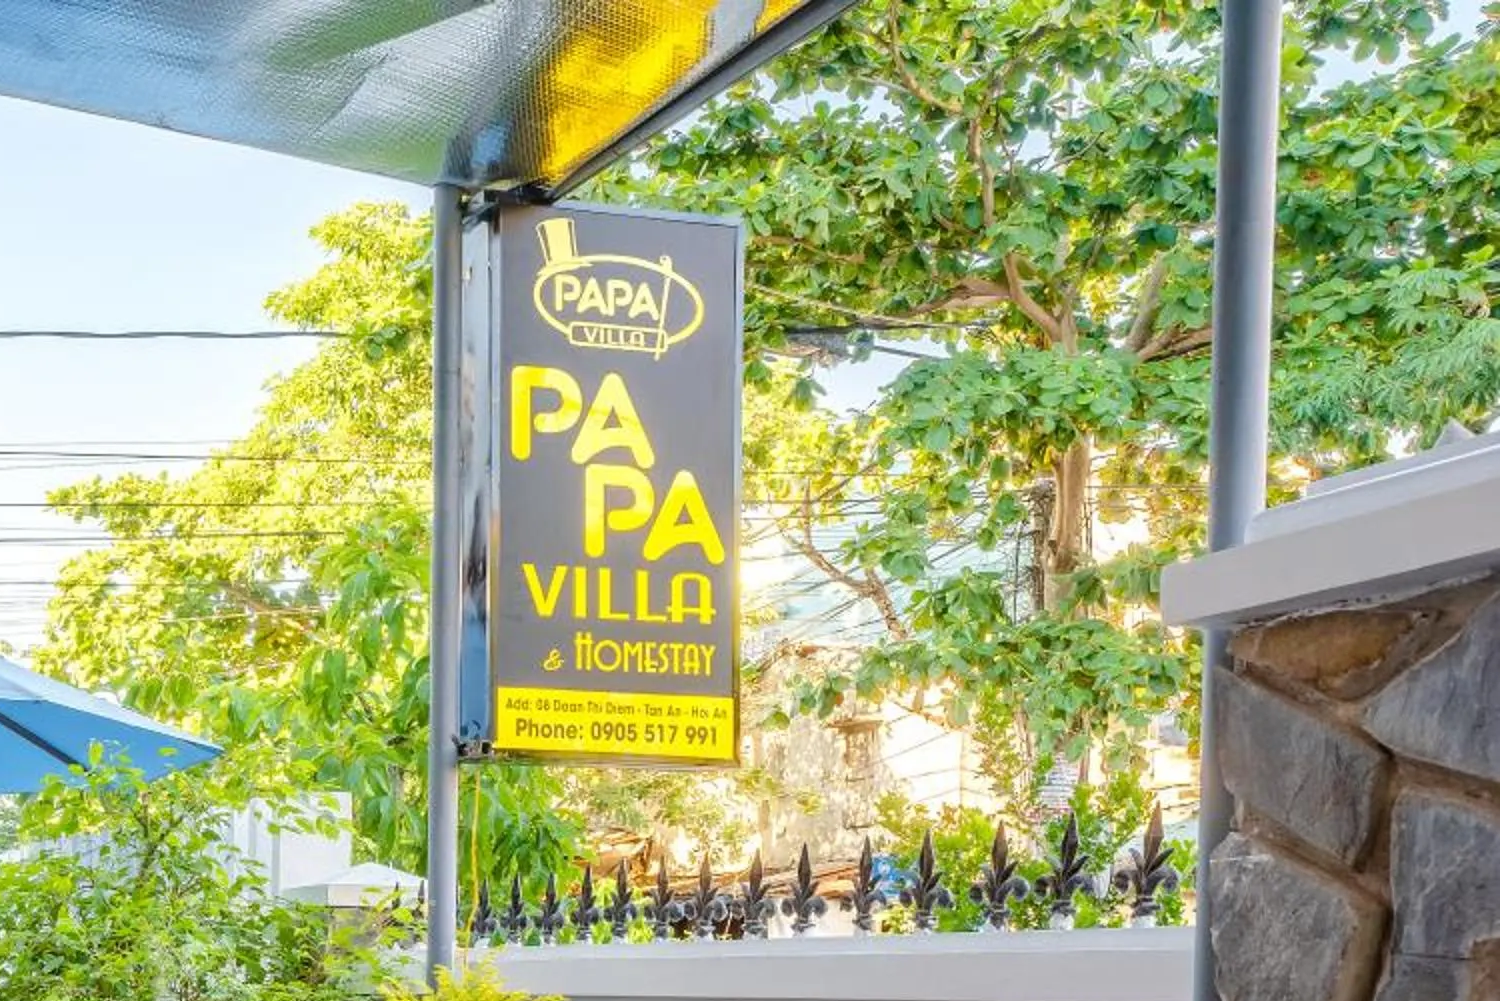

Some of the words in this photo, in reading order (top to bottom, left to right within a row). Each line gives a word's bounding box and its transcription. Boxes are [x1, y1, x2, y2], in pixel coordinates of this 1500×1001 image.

[554, 273, 660, 321] PAPA
[583, 326, 645, 347] VILLA
[521, 563, 716, 625] VILLA
[543, 648, 565, 671] &
[515, 718, 583, 739] Phone:
[591, 721, 637, 742] 0905
[644, 722, 678, 744] 517
[685, 725, 717, 747] 991
